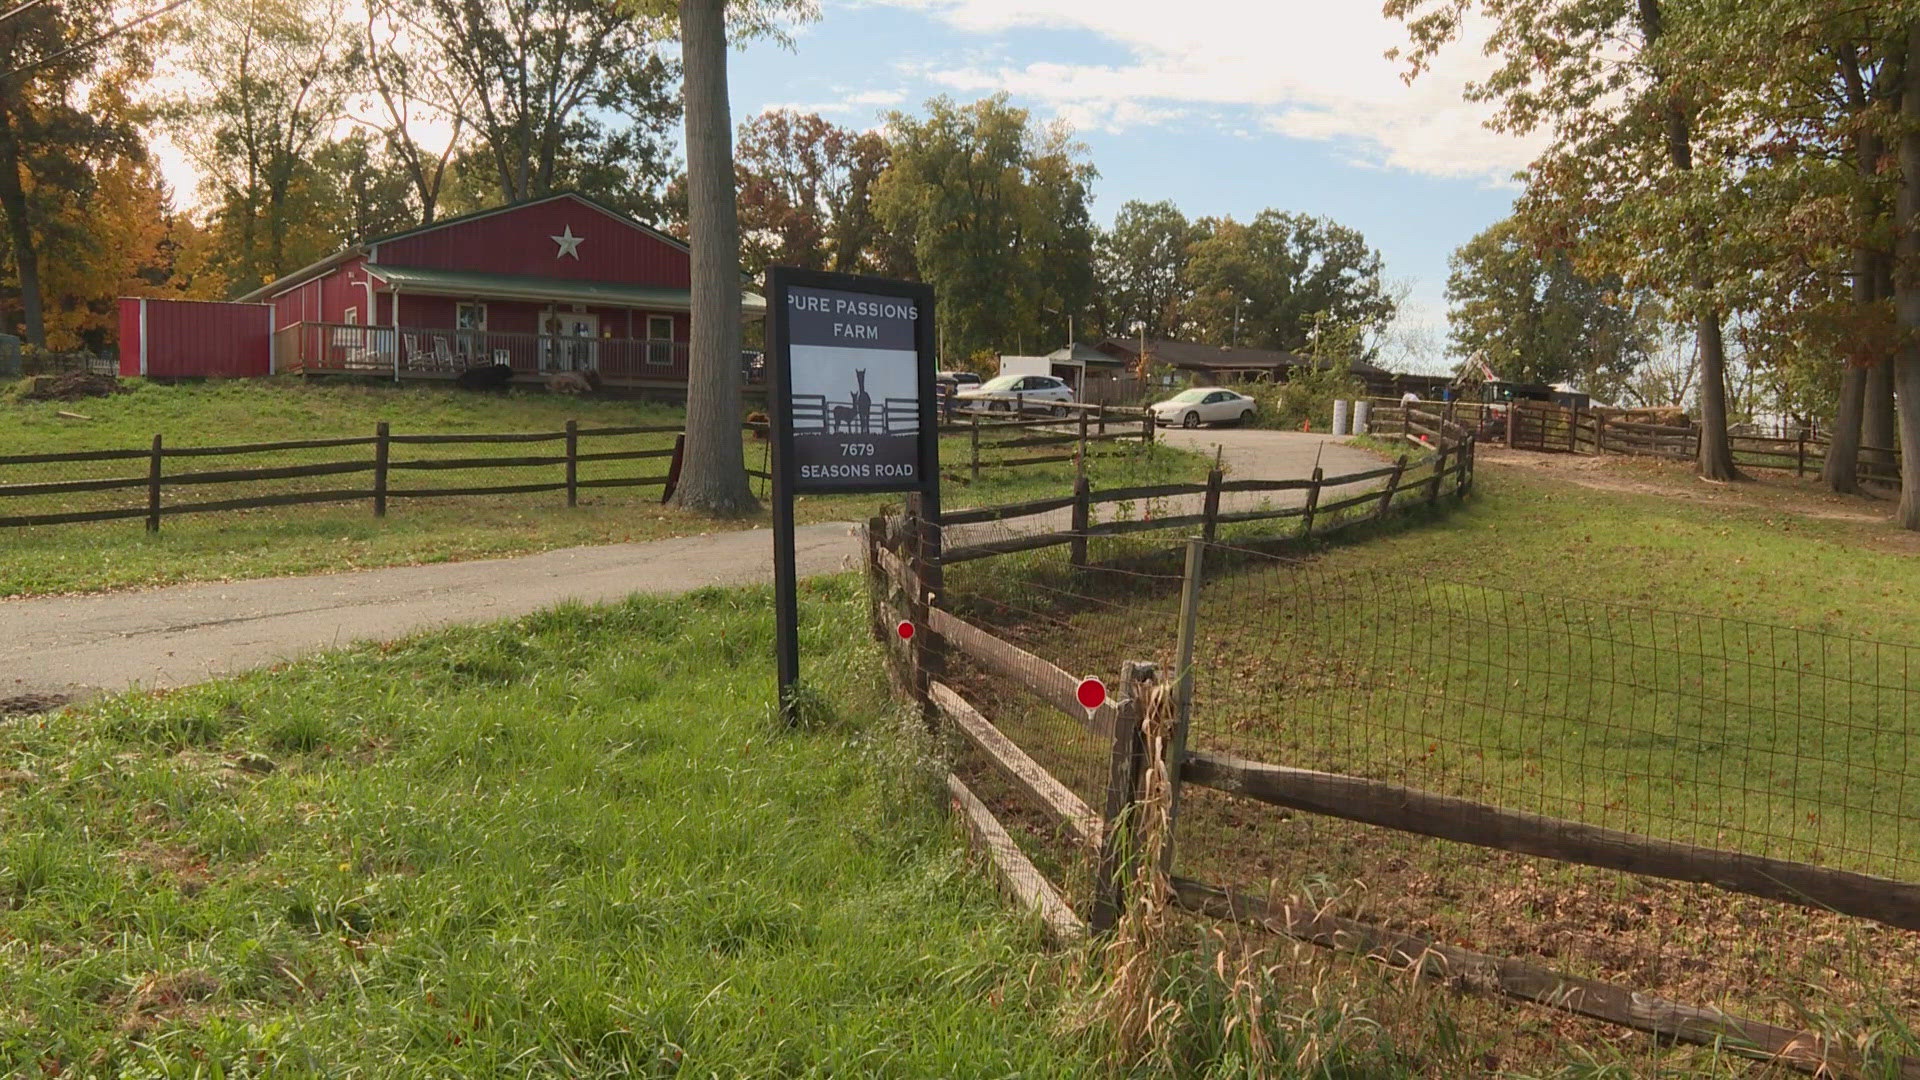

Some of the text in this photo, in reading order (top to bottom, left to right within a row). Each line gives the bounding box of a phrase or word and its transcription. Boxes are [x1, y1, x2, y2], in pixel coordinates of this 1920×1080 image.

[836, 299, 918, 320] PASSIONS
[834, 322, 878, 339] FARM
[840, 443, 875, 456] 7679
[801, 464, 913, 478] SEASONS ROAD
